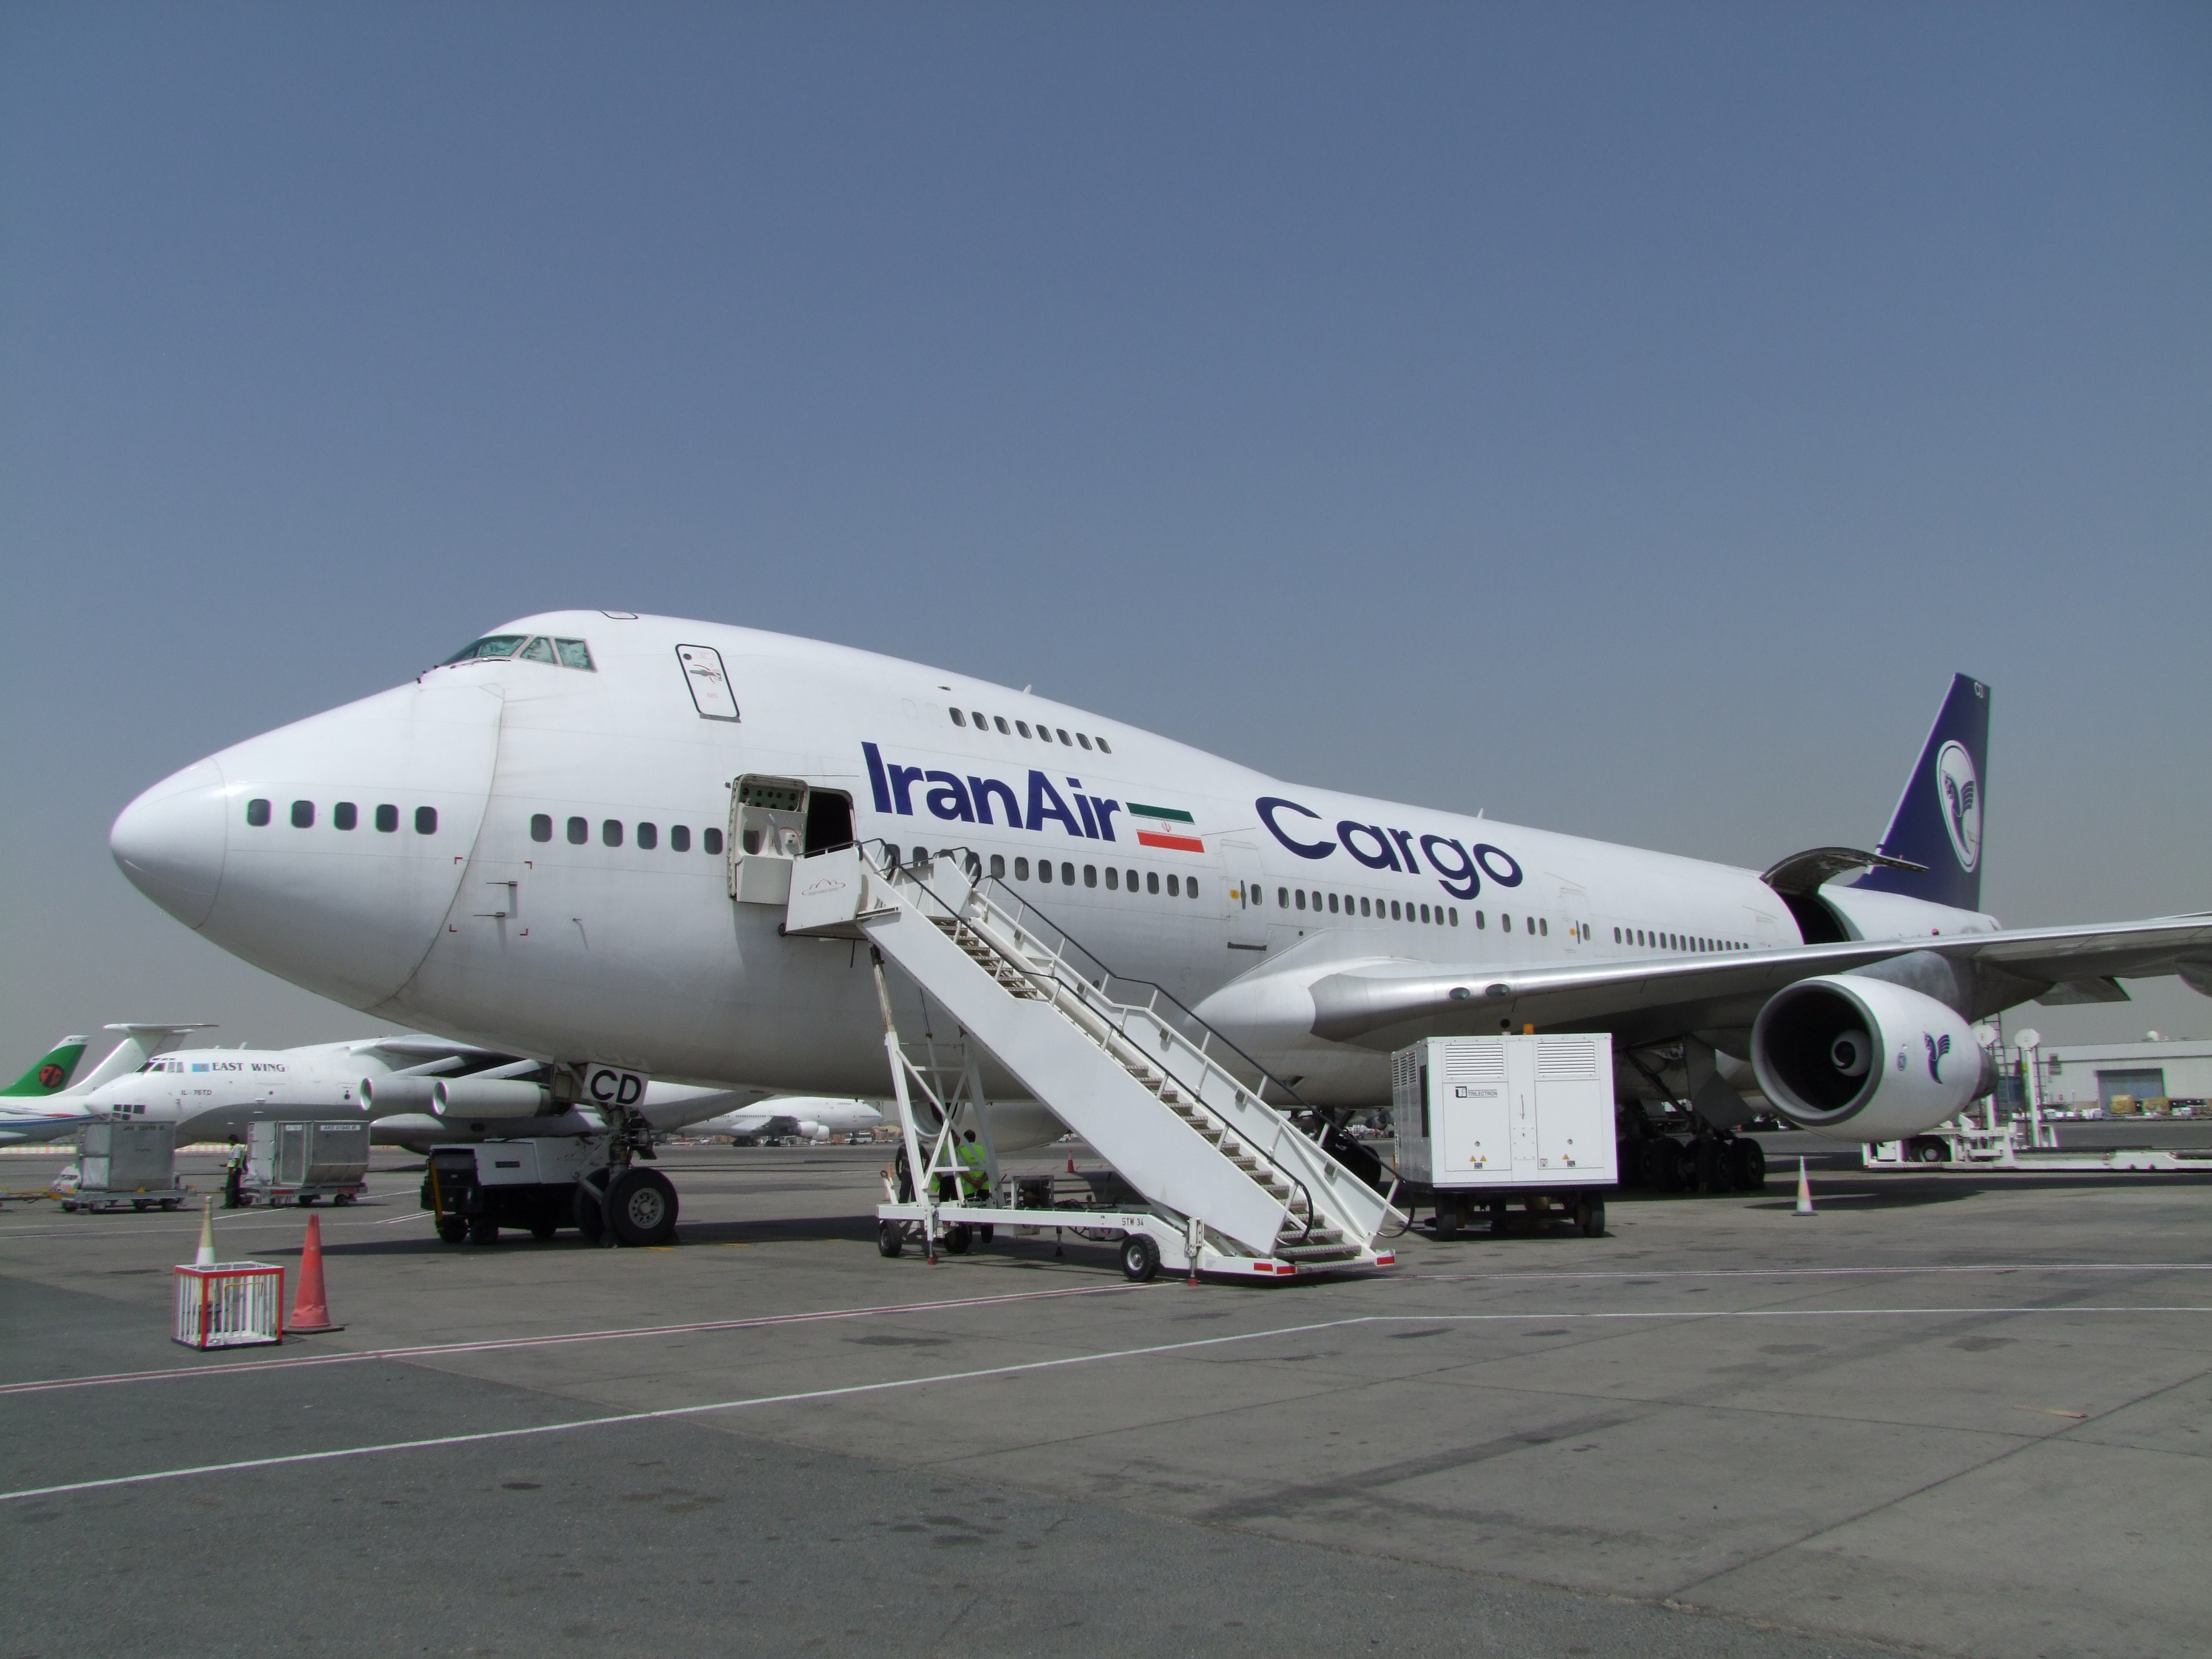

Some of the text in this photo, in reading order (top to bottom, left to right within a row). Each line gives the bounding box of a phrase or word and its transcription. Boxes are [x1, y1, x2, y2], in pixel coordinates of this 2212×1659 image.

[861, 741, 1121, 842] IranAir
[1255, 797, 1524, 900] Cargo
[212, 1062, 286, 1072] EAST WING
[590, 1069, 642, 1105] CD
[1122, 1217, 1144, 1226] STW 34
